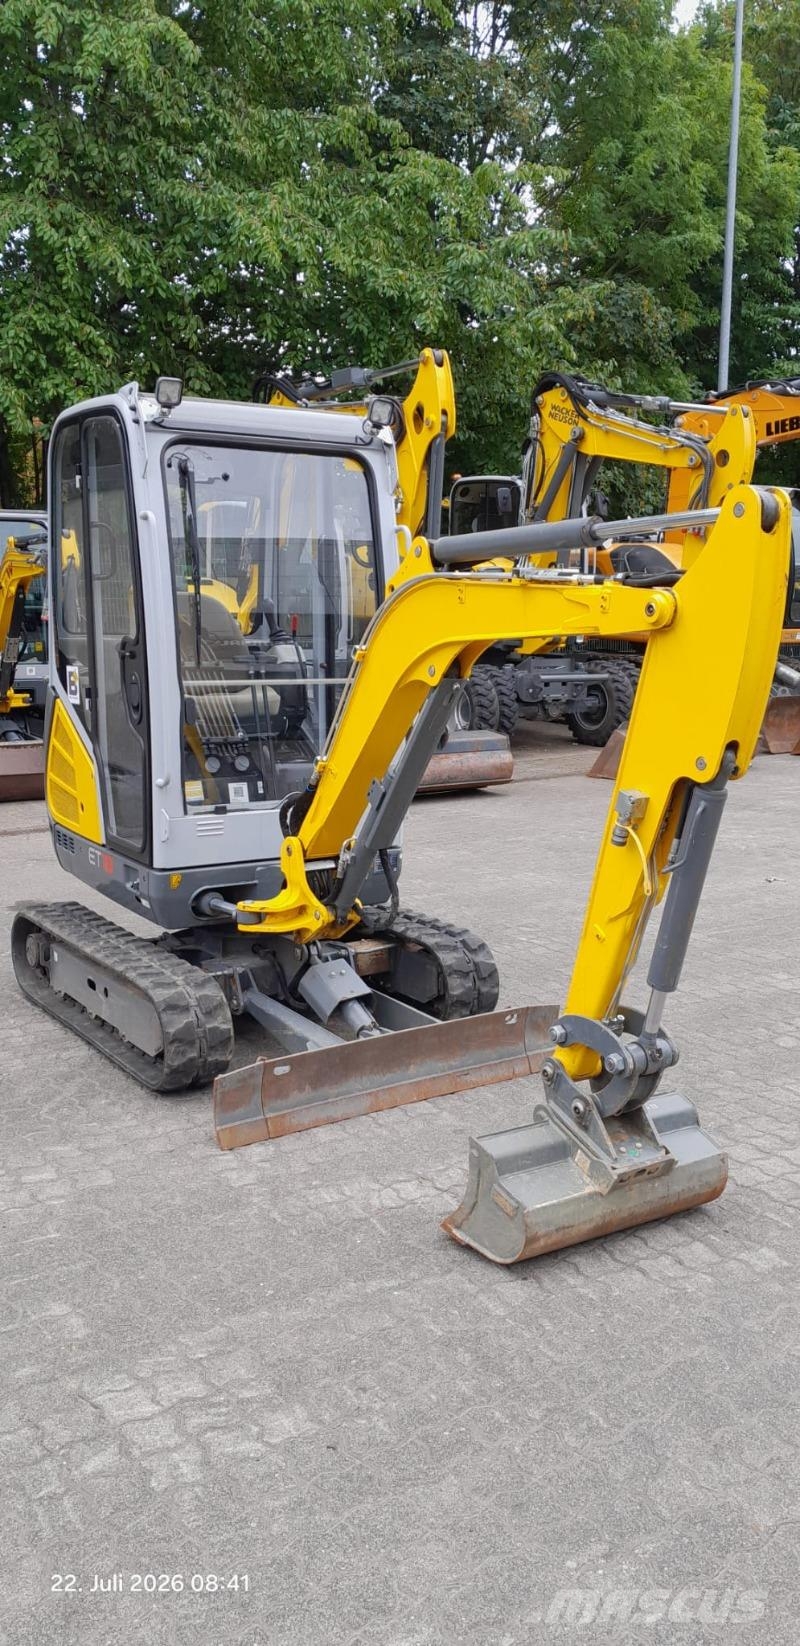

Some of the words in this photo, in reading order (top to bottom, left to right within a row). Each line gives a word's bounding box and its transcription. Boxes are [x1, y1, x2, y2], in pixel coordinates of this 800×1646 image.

[548, 410, 580, 427] NEUSON
[550, 402, 580, 420] WACKER
[765, 415, 800, 437] LIEB
